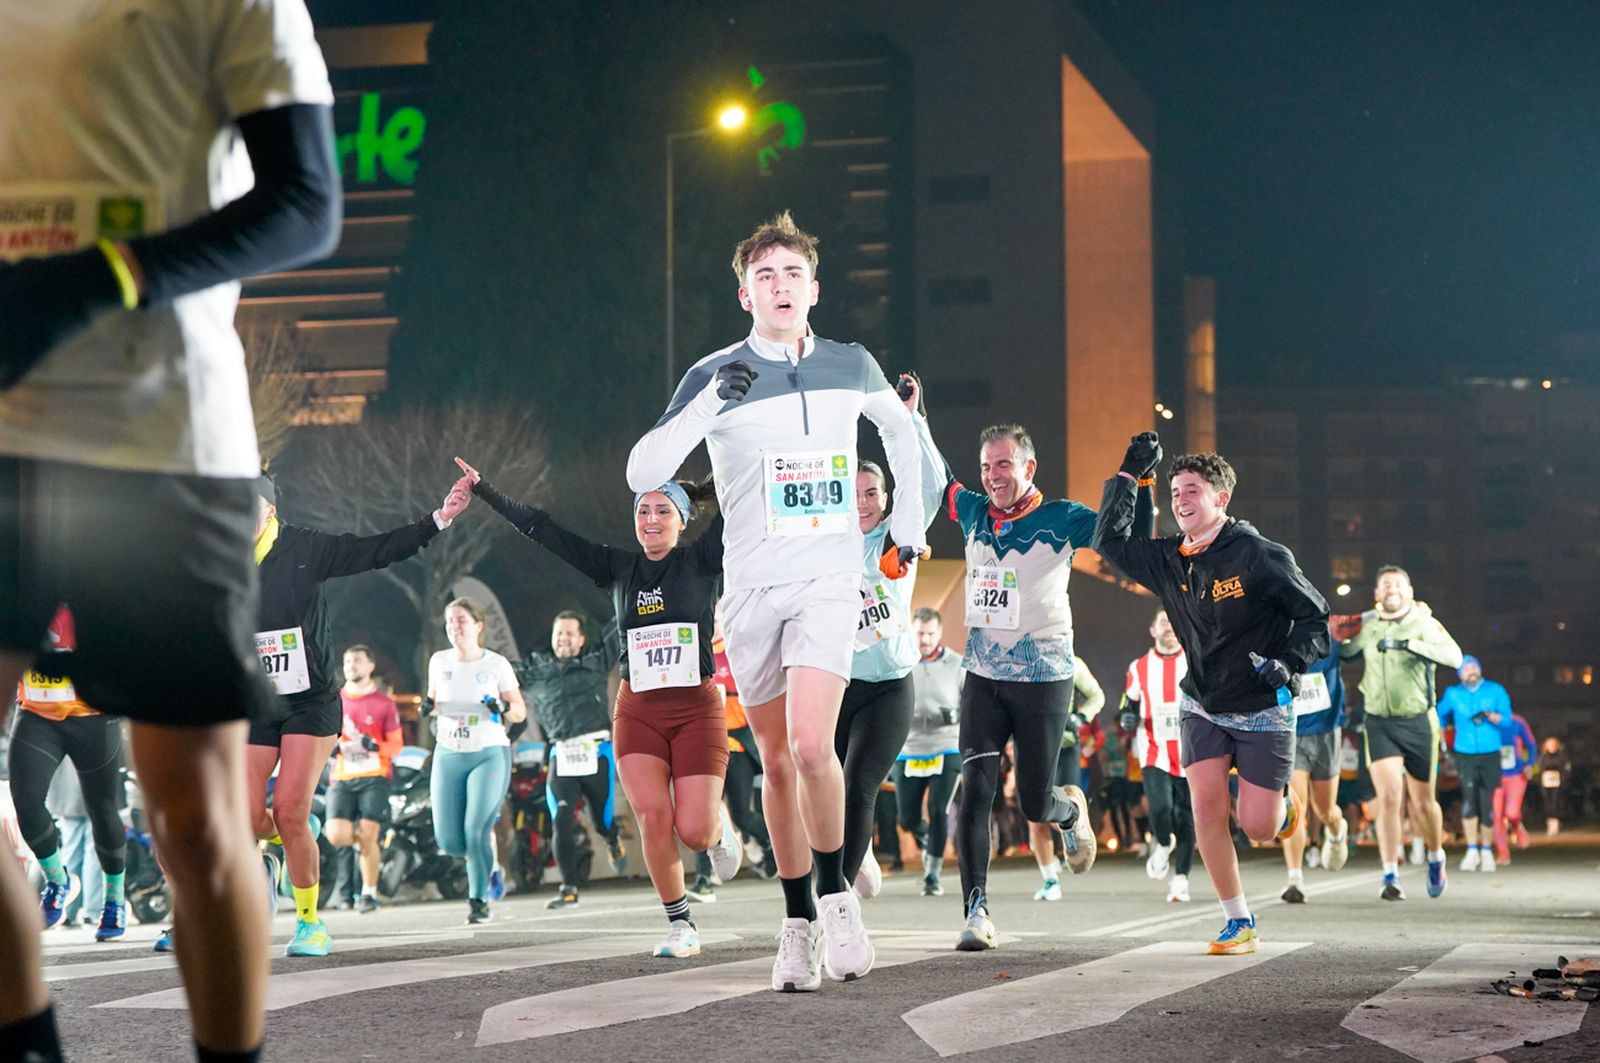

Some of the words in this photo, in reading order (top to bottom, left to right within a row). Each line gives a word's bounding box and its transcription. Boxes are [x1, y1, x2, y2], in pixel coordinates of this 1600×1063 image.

[815, 459, 825, 469] DE
[776, 473, 794, 482] SAN
[784, 480, 843, 507] 8349
[1212, 580, 1242, 598] ULTRA
[637, 603, 665, 616] BOX
[645, 646, 682, 668] 1477
